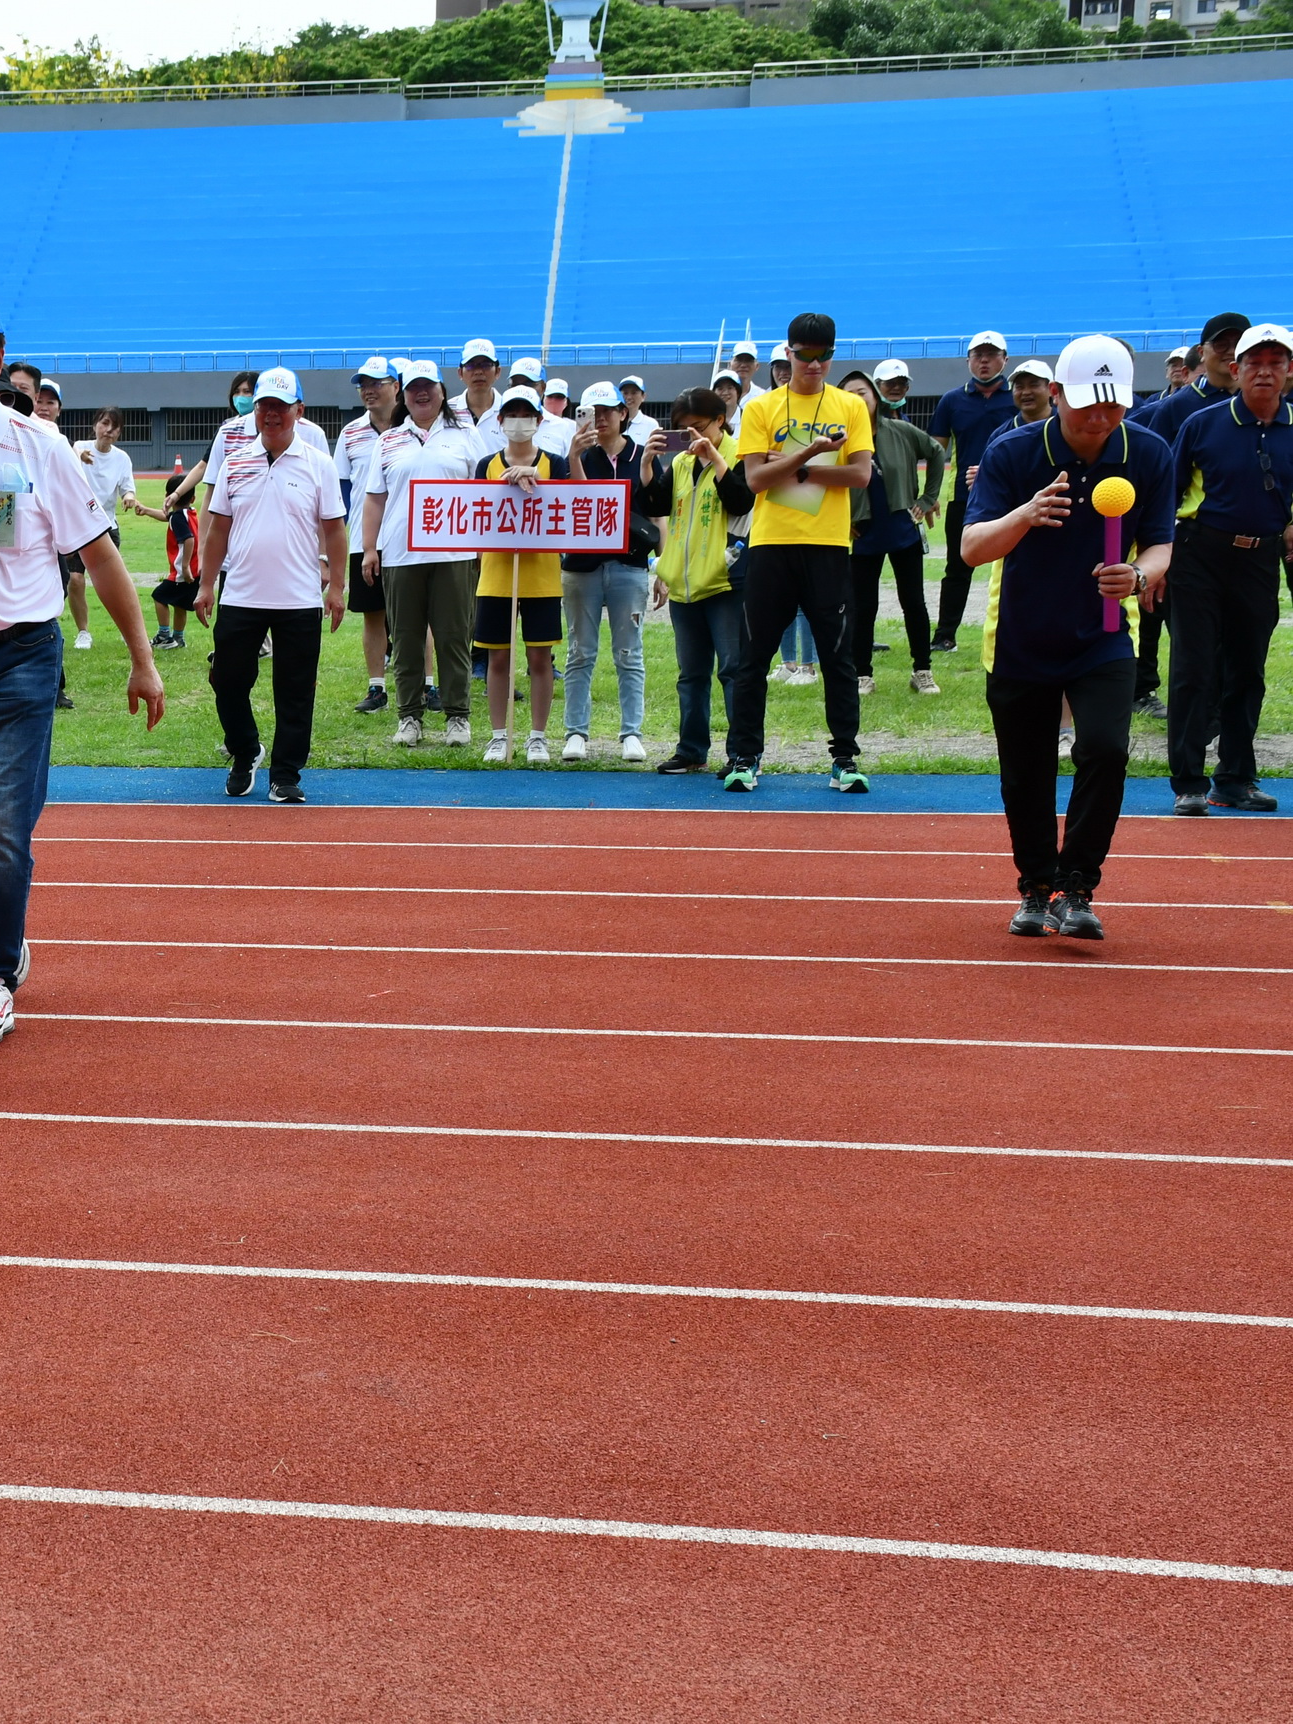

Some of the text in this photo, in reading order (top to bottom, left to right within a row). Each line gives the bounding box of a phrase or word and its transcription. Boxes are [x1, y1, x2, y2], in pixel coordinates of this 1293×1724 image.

[422, 496, 619, 537] 彰化市公所主管隊
